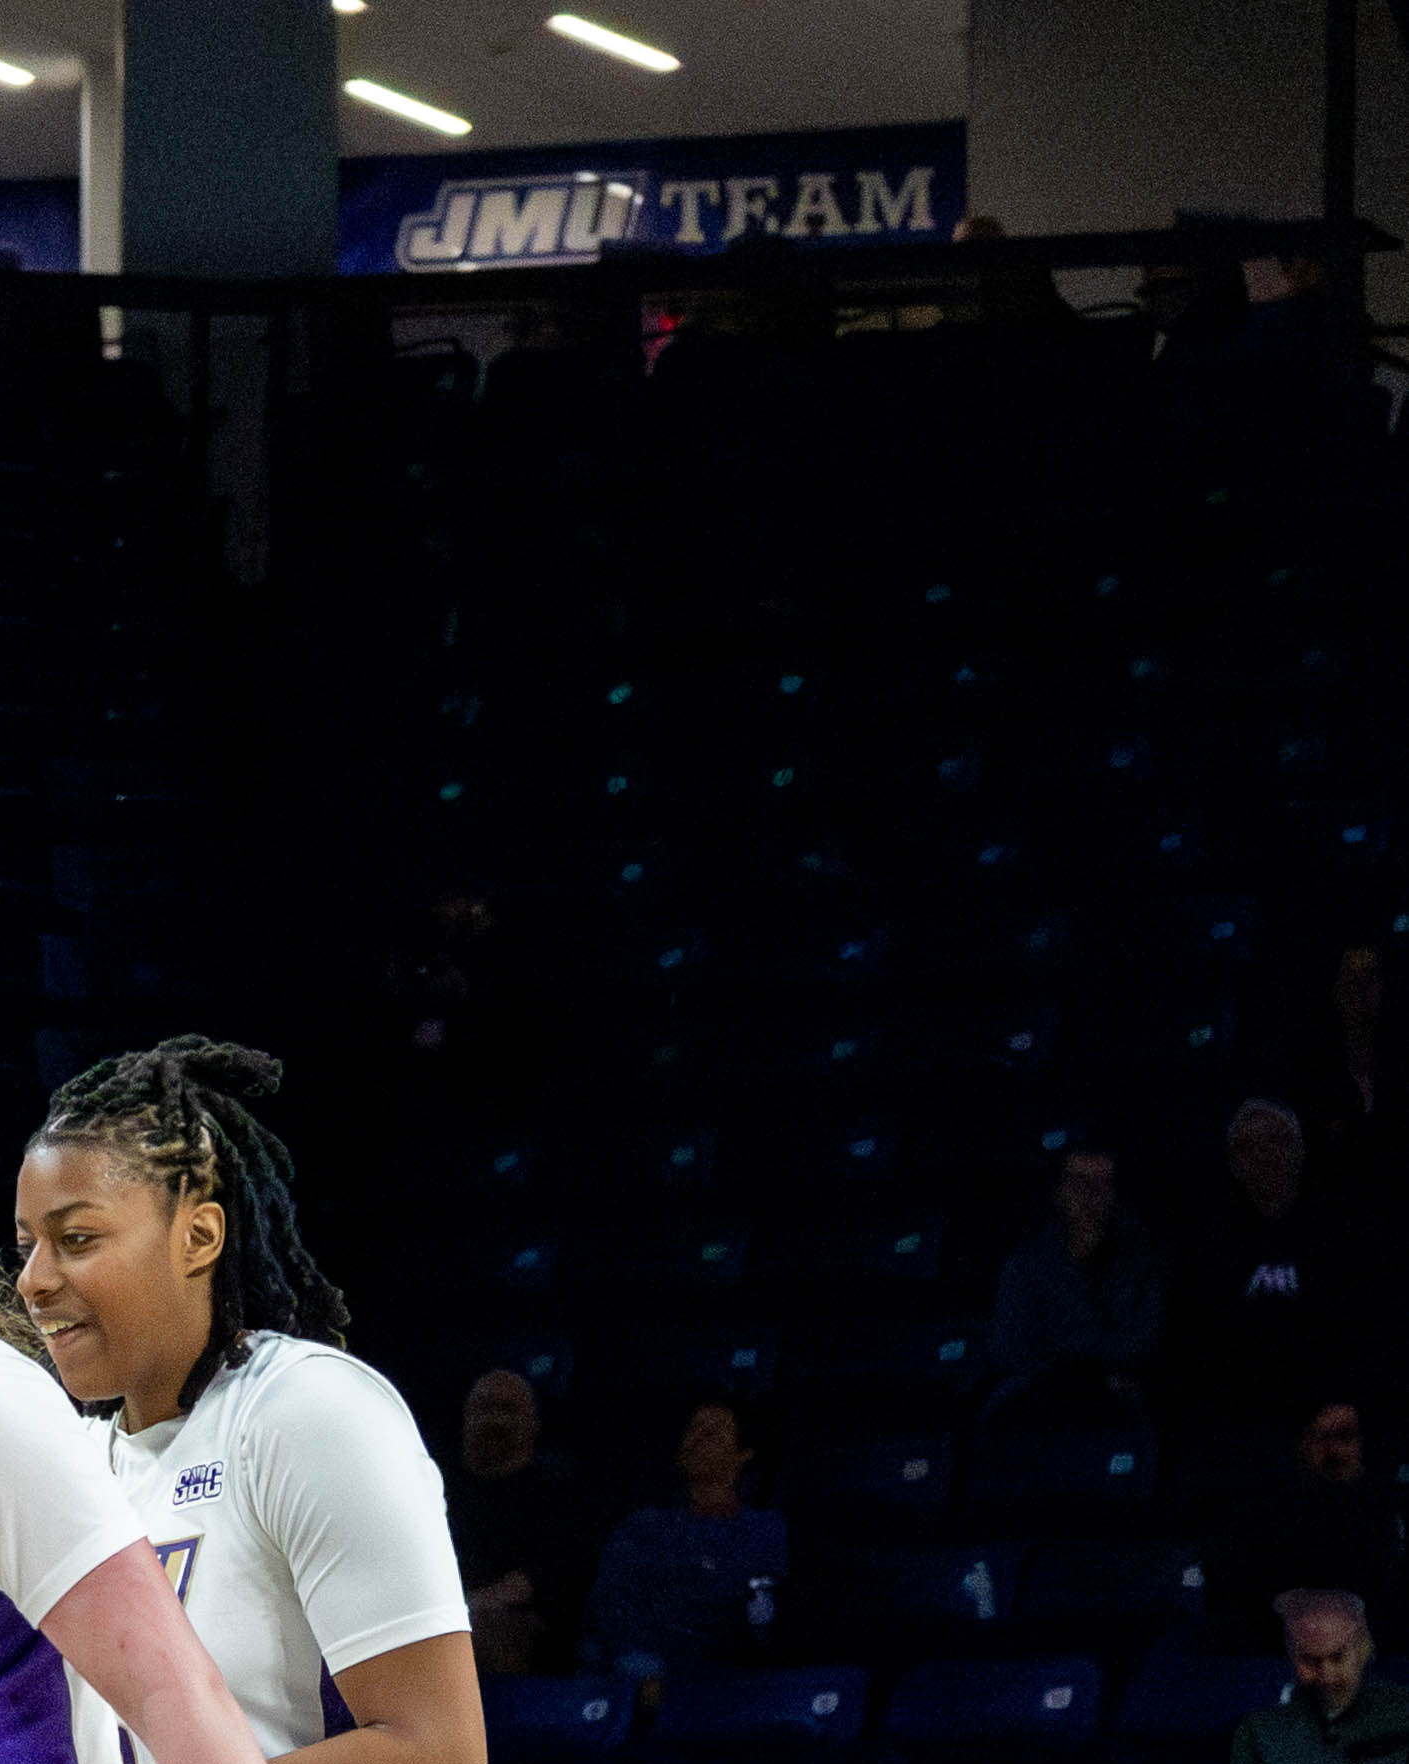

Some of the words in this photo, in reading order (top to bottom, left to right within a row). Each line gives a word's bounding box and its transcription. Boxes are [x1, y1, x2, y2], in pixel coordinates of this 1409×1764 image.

[400, 172, 644, 272] JMU
[660, 166, 939, 244] TEAM
[173, 1461, 223, 1505] SBC
